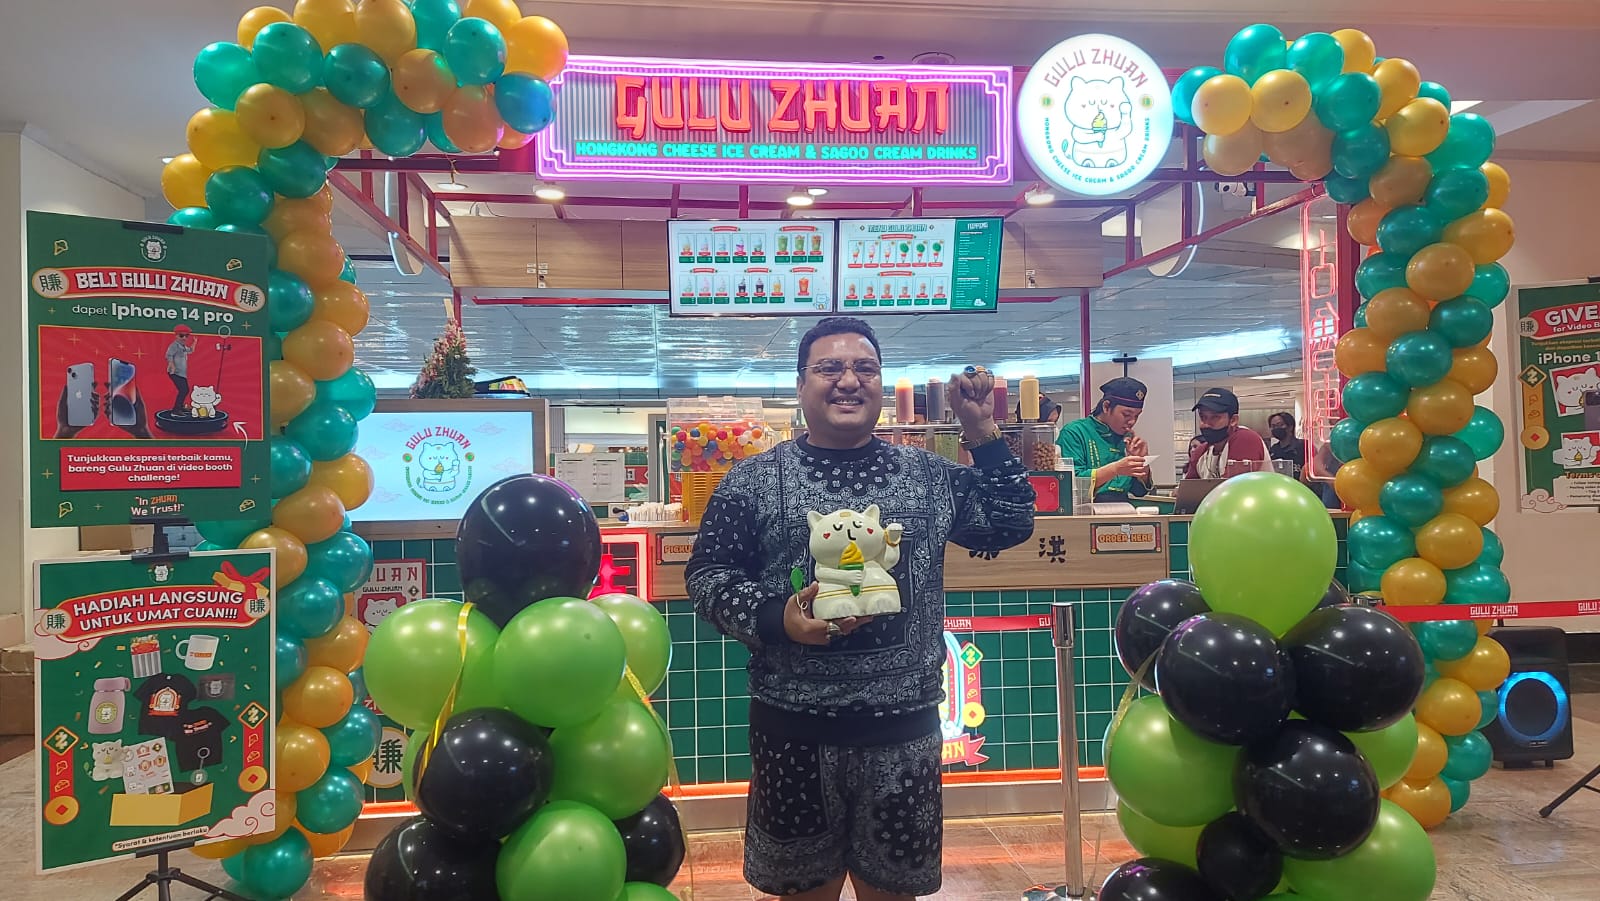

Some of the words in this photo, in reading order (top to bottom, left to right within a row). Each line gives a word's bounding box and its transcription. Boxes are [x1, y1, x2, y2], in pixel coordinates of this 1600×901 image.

[1044, 50, 1086, 87] GULU
[1091, 48, 1148, 88] ZHUAN
[615, 75, 751, 139] GULU
[768, 78, 949, 135] ZHUAN
[575, 142, 658, 157] HONGKONG
[662, 143, 717, 158] CHEESE
[722, 144, 745, 158] ICE
[749, 145, 800, 159] CREAM
[805, 145, 817, 160] &
[821, 146, 869, 160] SAGOO
[874, 146, 922, 160] CREAM
[927, 147, 977, 161] DRINKS
[76, 272, 118, 289] BELI
[122, 272, 167, 290] GULU
[171, 275, 229, 300] ZHUAN
[72, 304, 108, 316] dapet
[112, 303, 178, 320] Iphone
[181, 307, 200, 321] 14
[204, 311, 234, 325] pro
[1545, 304, 1600, 326] GIVE
[1568, 322, 1593, 331] Video
[1538, 352, 1591, 365] iPhone
[405, 427, 432, 450] GULU
[435, 426, 471, 450] ZHUAN
[68, 454, 122, 465] Tunjukkan
[124, 454, 166, 465] ekspresi
[167, 453, 202, 463] terbaik
[203, 453, 233, 463] kamu,
[69, 464, 106, 474] bareng
[107, 464, 132, 473] Gulu
[134, 463, 165, 473] Zhuan
[167, 463, 176, 472] di
[178, 463, 203, 472] video
[205, 463, 232, 472] booth
[128, 472, 181, 483] challenge!
[131, 506, 148, 516] We
[1098, 533, 1128, 543] ORDER
[1130, 533, 1153, 542] HERE
[664, 544, 692, 554] PICKU
[368, 566, 418, 582] UAN
[74, 594, 145, 617] HADIAH
[149, 591, 243, 606] LANGSUNG
[1470, 606, 1490, 615] GULU
[1492, 605, 1518, 614] ZHUAN
[1578, 602, 1597, 611] GULU
[80, 612, 133, 631] UNTUK
[137, 608, 181, 623] UMAT
[184, 607, 238, 619] CUAN!!!
[1039, 617, 1051, 627] GU
